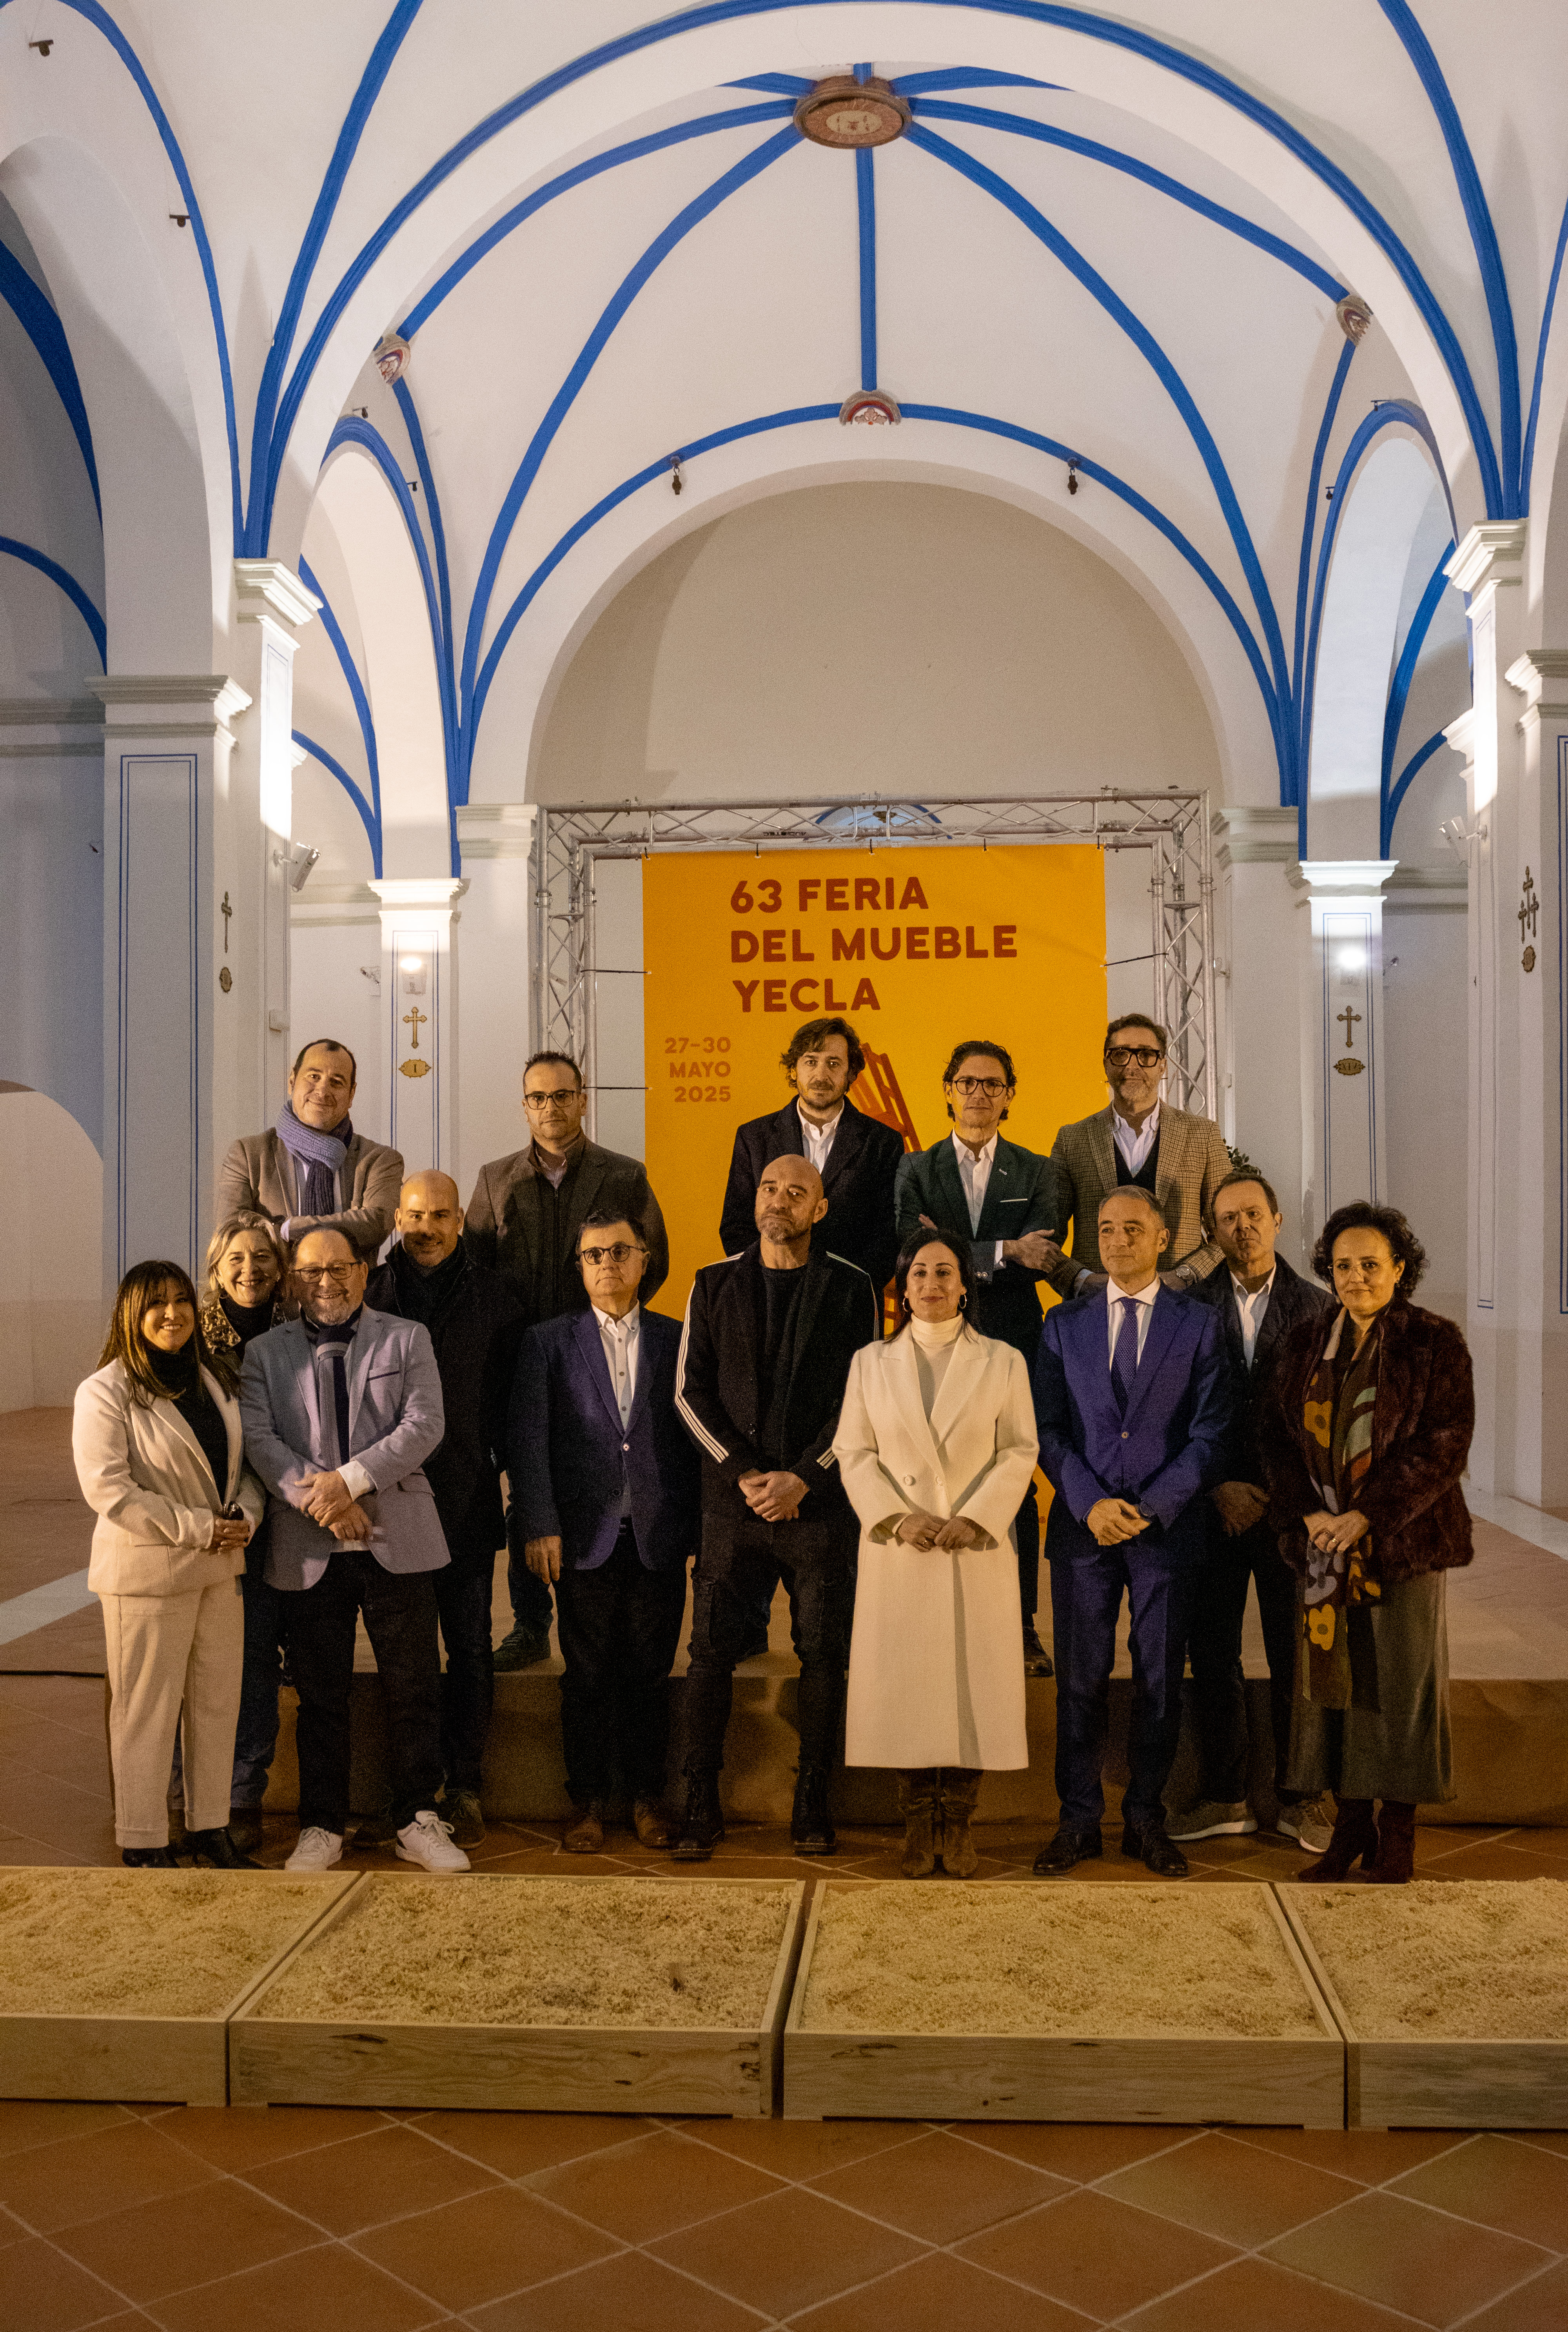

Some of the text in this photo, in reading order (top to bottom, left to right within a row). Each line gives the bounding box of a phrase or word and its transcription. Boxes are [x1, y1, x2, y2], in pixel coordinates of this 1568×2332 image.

[731, 877, 928, 913] 63 FERIA
[731, 925, 1017, 962] DEL MUEBLE
[733, 978, 880, 1012] YECLA
[670, 1062, 730, 1078] MAYO
[675, 1086, 730, 1102] 2025
